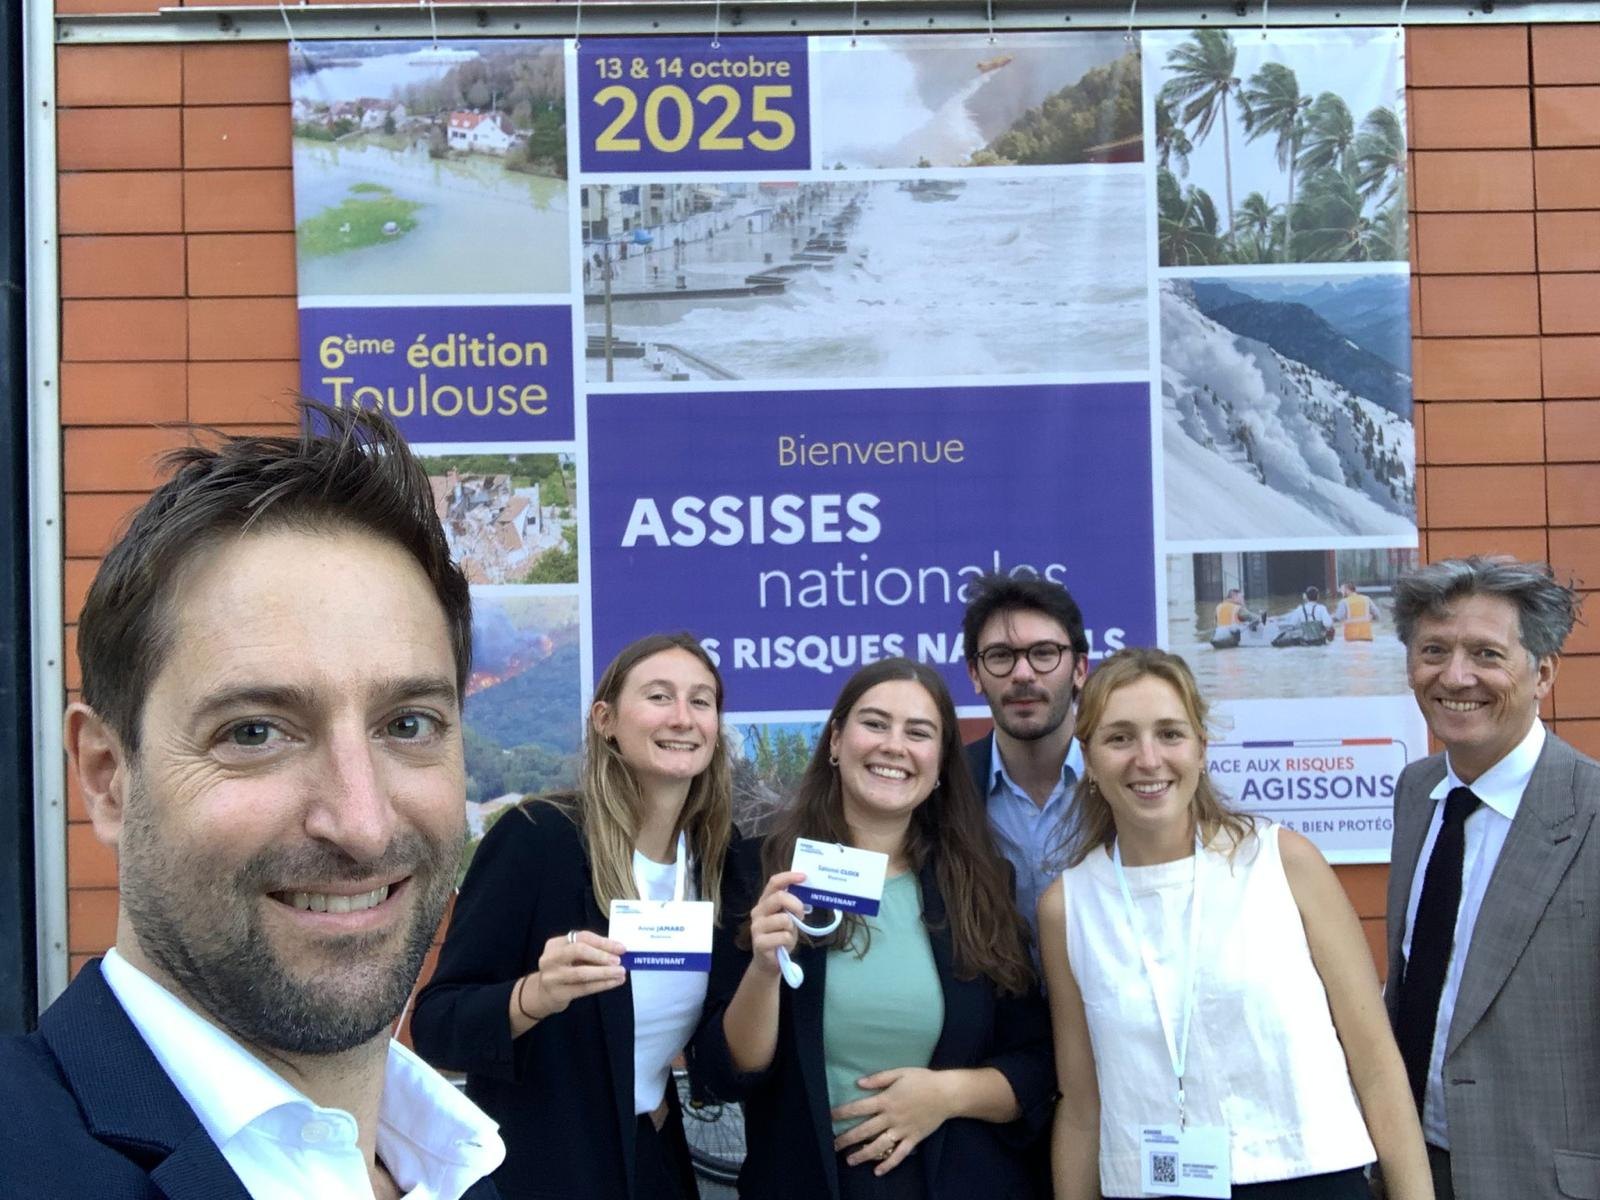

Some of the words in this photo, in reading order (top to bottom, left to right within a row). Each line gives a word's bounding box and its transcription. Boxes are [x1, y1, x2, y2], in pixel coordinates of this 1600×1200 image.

[595, 57, 623, 79] 13
[630, 57, 649, 79] &
[656, 57, 684, 78] 14
[690, 55, 791, 78] octobre
[592, 84, 797, 153] 2025
[319, 334, 395, 369] 6ème
[407, 333, 548, 368] édition
[321, 373, 548, 417] Toulouse
[777, 434, 965, 466] Bienvenue
[620, 491, 882, 548] ASSISES
[733, 632, 905, 674] RISQUES
[1207, 759, 1241, 774] ACE
[1245, 758, 1281, 773] AUX
[1286, 756, 1355, 774] RISQUES
[1240, 774, 1394, 801] AGISSONS
[1302, 820, 1334, 833] BIEN
[810, 893, 857, 907] INTERVENANT
[633, 957, 686, 966] INTERVENANT
